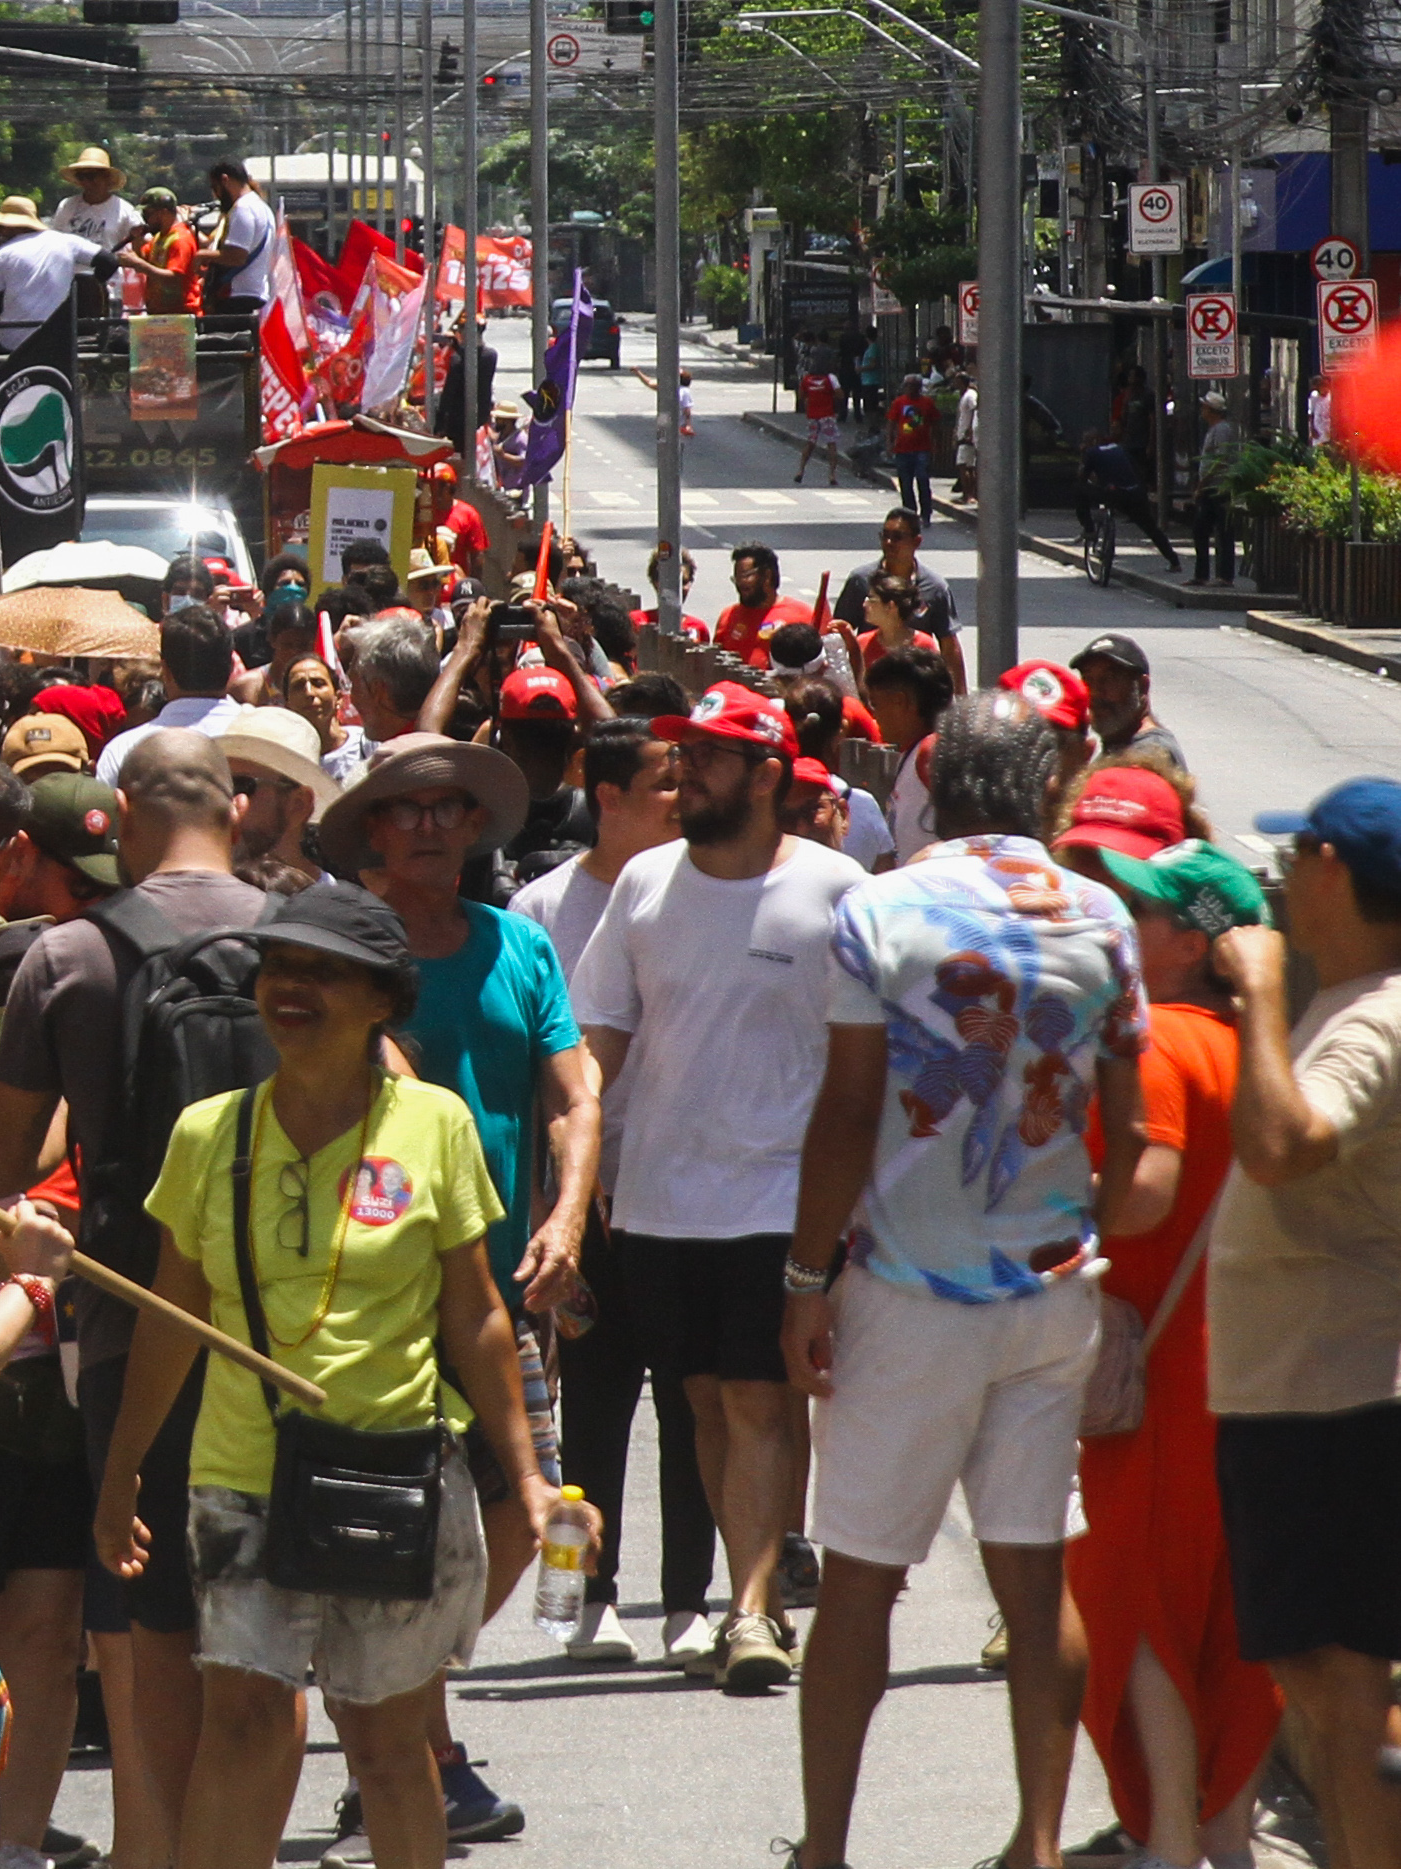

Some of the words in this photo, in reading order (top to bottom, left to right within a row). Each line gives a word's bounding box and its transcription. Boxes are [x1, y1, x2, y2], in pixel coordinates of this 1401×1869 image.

[1143, 196, 1167, 210] 40
[1315, 248, 1354, 270] 40
[1195, 345, 1230, 355] EXCETO
[1328, 337, 1372, 350] EXCETO
[1197, 886, 1234, 927] LULA
[1187, 900, 1220, 932] 2022
[360, 1196, 393, 1207] SUZI
[356, 1207, 396, 1220] 13000
